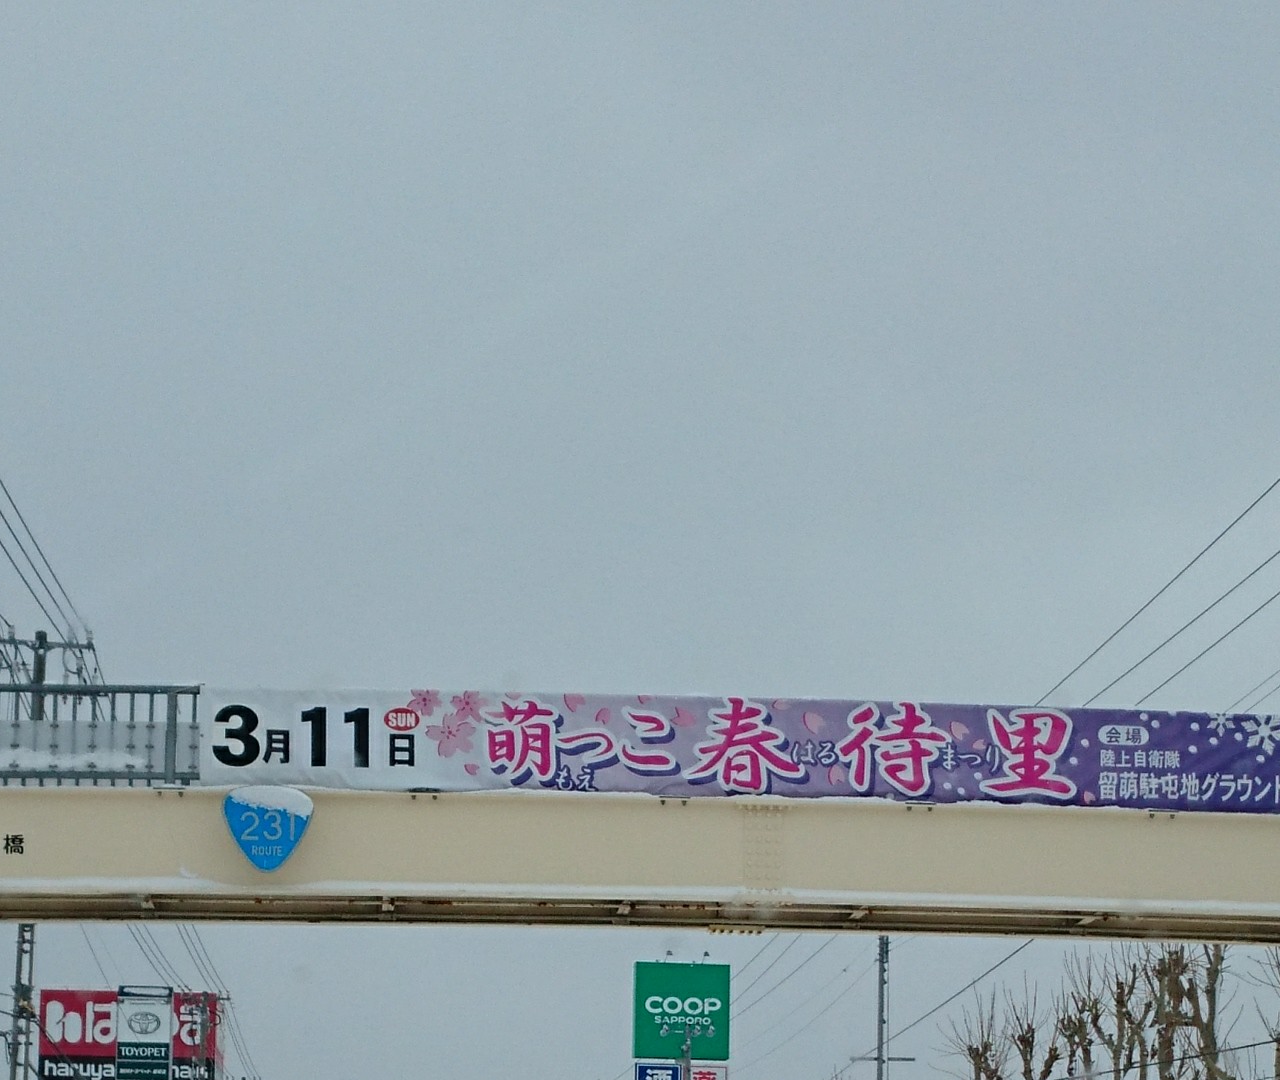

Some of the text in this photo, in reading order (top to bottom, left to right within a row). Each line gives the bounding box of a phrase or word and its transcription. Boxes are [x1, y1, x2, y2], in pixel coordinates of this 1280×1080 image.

[388, 711, 415, 728] SUN
[1105, 729, 1143, 744] 会場
[791, 742, 836, 768] はる
[1100, 749, 1180, 769] 陸上自衛隊
[240, 811, 296, 842] 231
[251, 846, 283, 856] ROUTE
[645, 996, 721, 1015] COOP
[654, 1015, 711, 1025] SAPPORO
[120, 1046, 167, 1057] TOYOPET
